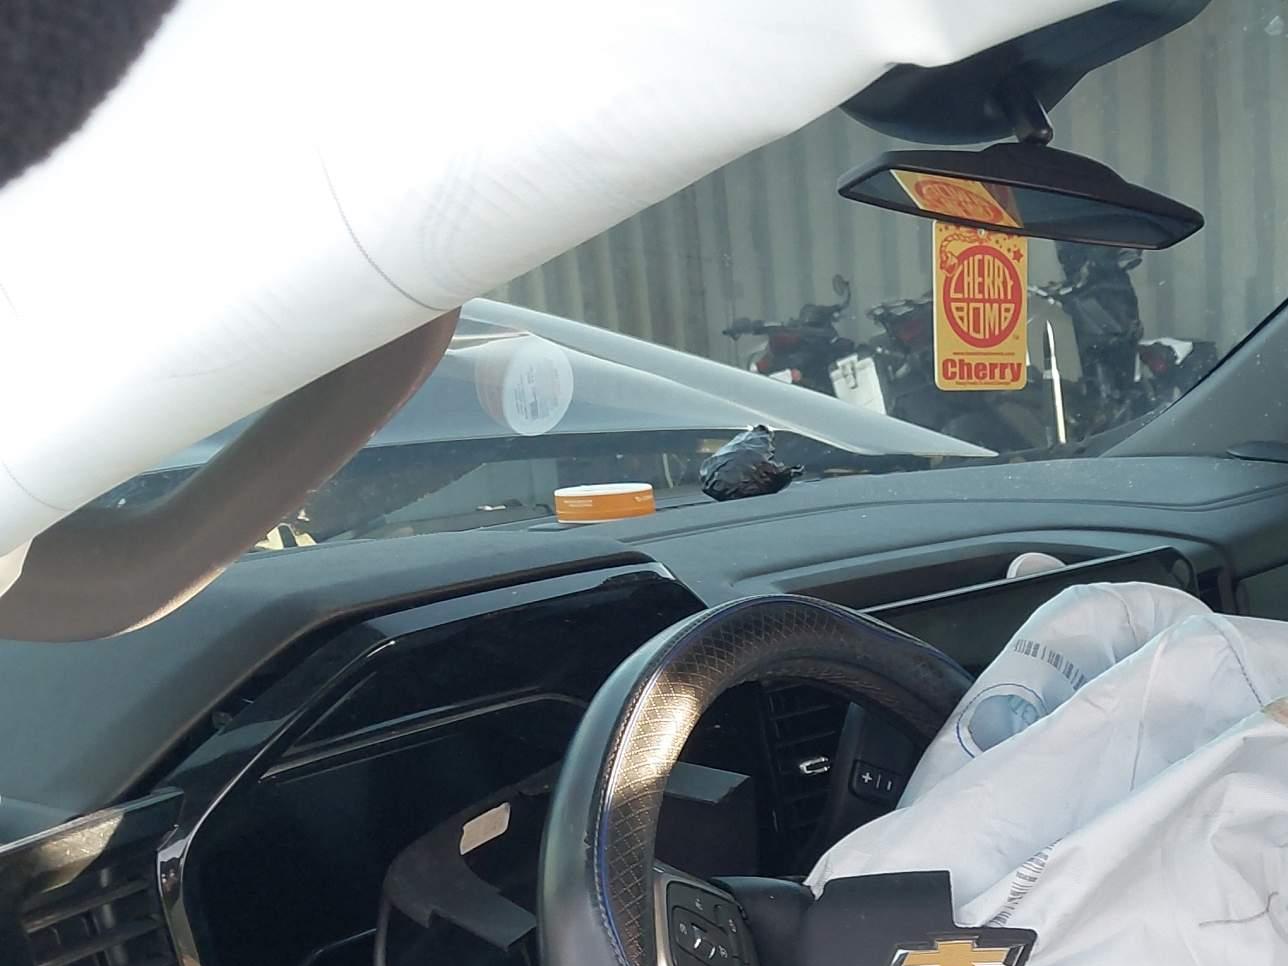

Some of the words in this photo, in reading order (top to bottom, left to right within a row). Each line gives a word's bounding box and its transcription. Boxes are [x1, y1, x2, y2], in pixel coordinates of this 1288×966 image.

[950, 254, 1014, 299] CHERRY
[950, 302, 1015, 339] BOMB
[942, 358, 1022, 382] Cherry
